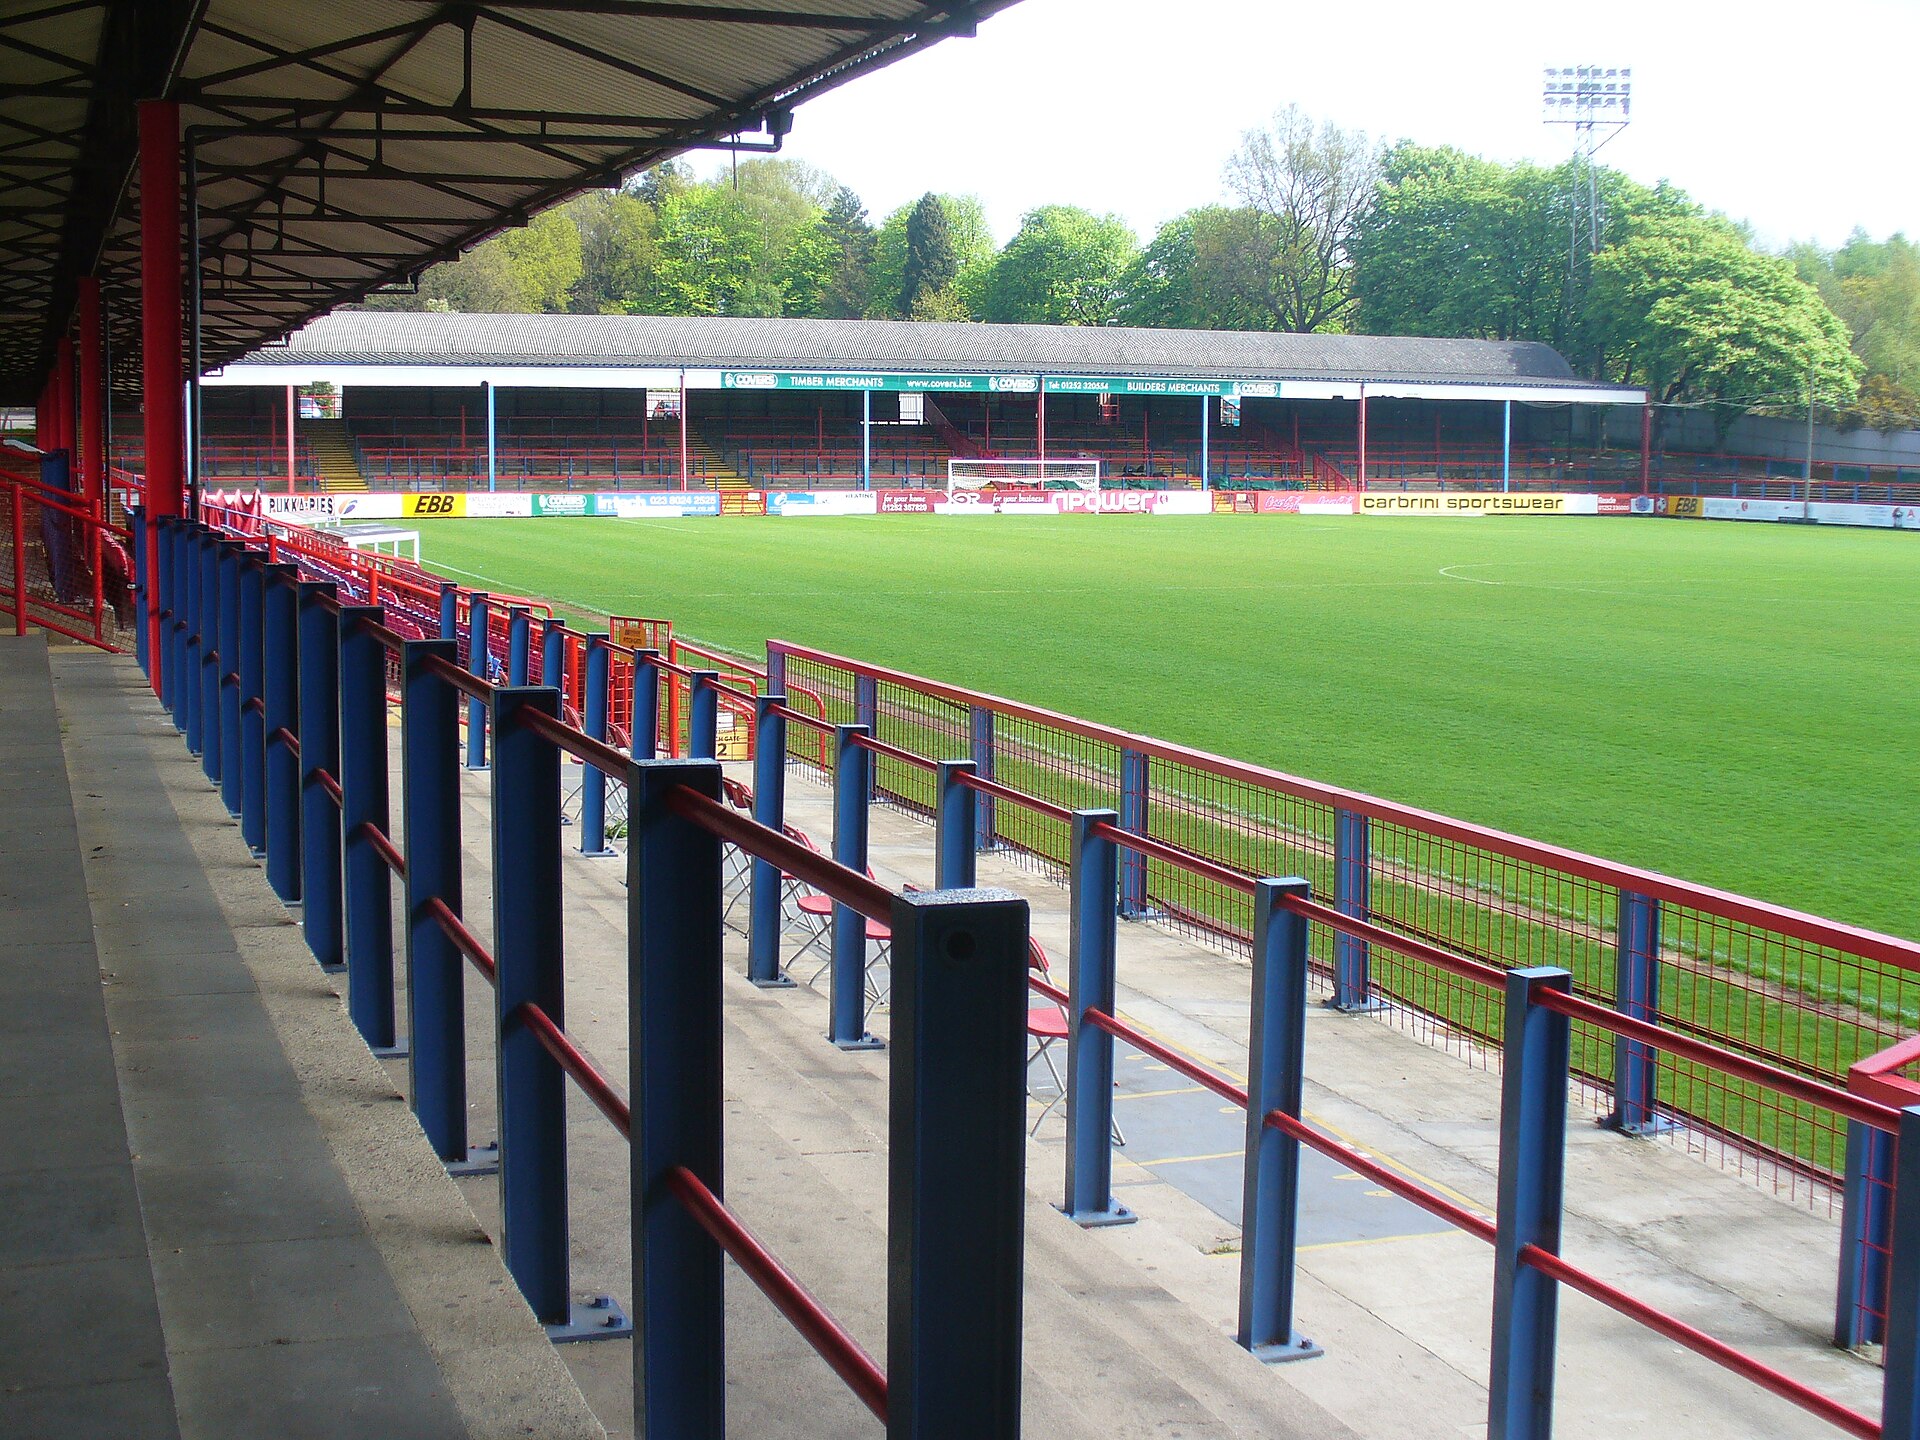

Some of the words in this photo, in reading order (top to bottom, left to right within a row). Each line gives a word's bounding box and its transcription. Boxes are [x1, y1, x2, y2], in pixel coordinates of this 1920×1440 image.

[735, 374, 775, 386] COVERS
[790, 376, 824, 387] TIMBER
[825, 376, 884, 388] MERCHANTS
[906, 377, 973, 389] www.covers.biz
[999, 378, 1036, 390] COVERS
[1061, 381, 1082, 390] 01252
[1126, 382, 1166, 392] BUILDERS
[1167, 383, 1220, 393] MERCHANTS
[1241, 383, 1276, 394] COVERS
[884, 492, 893, 504] for
[893, 496, 908, 504] your
[908, 493, 926, 503] home
[992, 492, 1002, 504] for
[1003, 496, 1018, 504] your
[1018, 492, 1045, 503] business
[1363, 496, 1439, 509] carbrini
[1446, 496, 1564, 510] sportswear
[414, 495, 455, 514] EBB
[1675, 497, 1698, 514] EBB
[717, 743, 727, 756] 2
